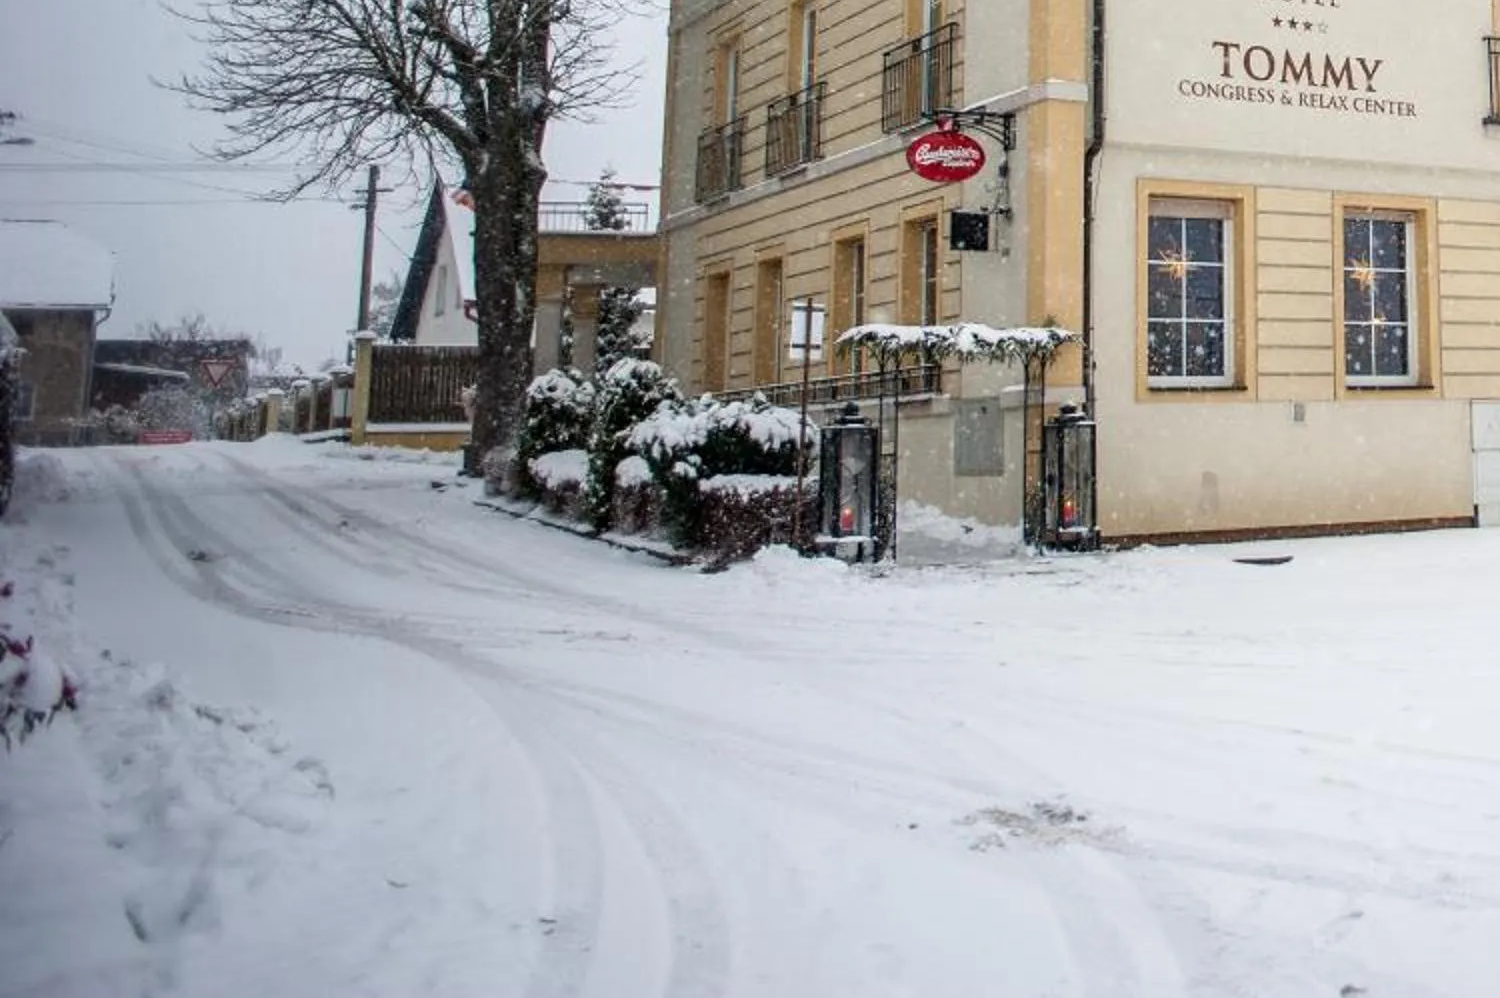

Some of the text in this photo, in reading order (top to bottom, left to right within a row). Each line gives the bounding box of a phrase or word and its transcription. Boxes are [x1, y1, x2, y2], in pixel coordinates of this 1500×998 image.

[1211, 40, 1384, 93] TOMMY
[1178, 78, 1418, 118] CONGRESS & RELAX CENTER
